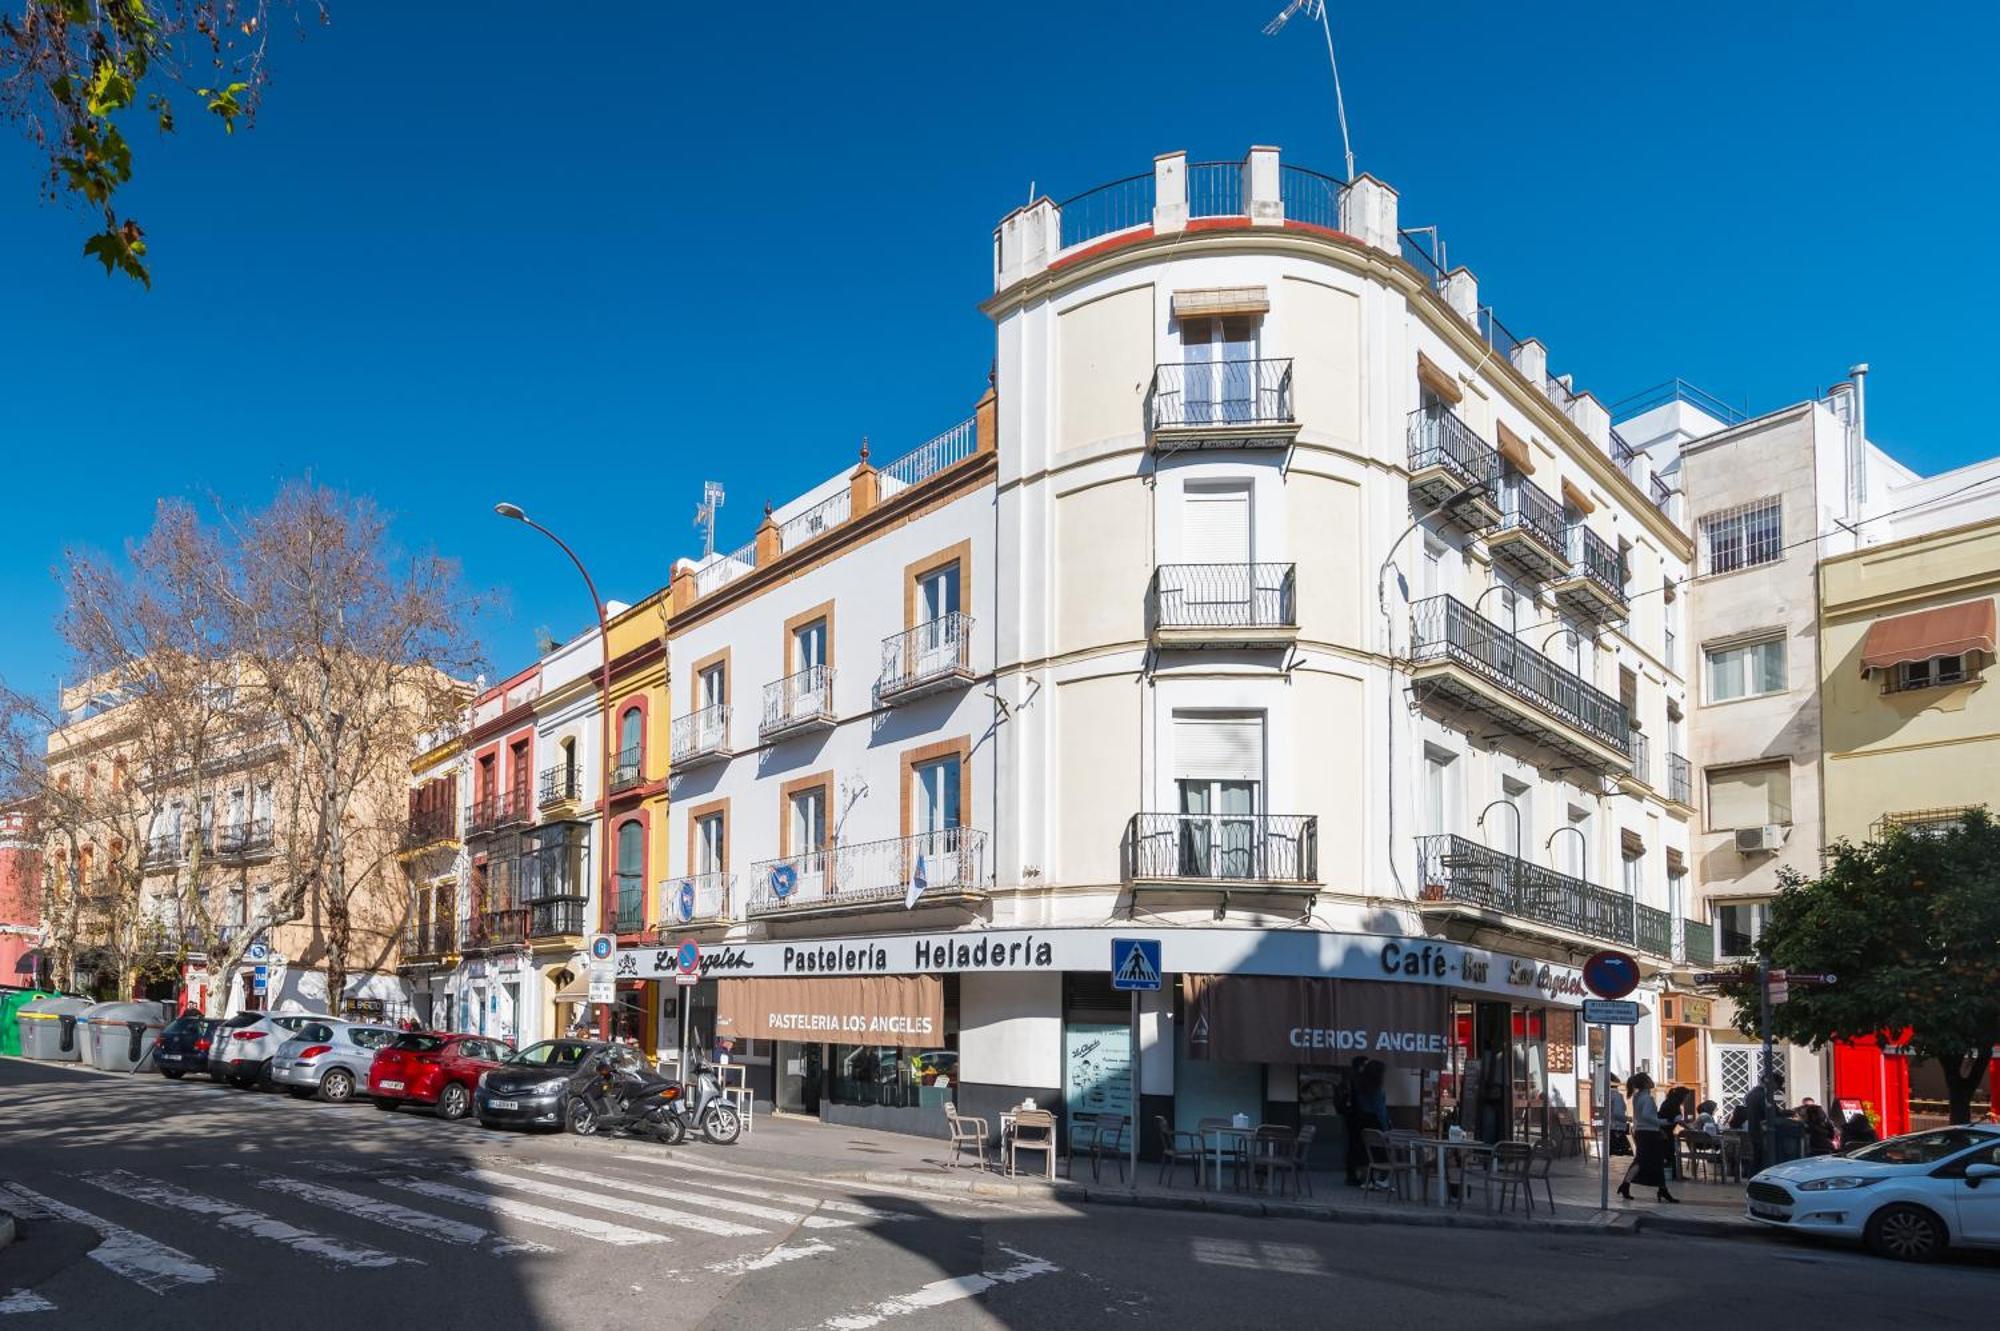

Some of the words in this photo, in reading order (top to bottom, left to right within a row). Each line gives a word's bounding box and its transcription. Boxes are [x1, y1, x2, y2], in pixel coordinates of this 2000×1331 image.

[699, 946, 754, 976] ngeles
[783, 943, 887, 972] Pastelería
[915, 936, 1053, 970] Heladería
[1536, 964, 1588, 999] Angeles
[768, 1013, 840, 1031] PASTELERIA
[843, 1015, 866, 1032] LOS
[869, 1017, 933, 1035] ANGELES
